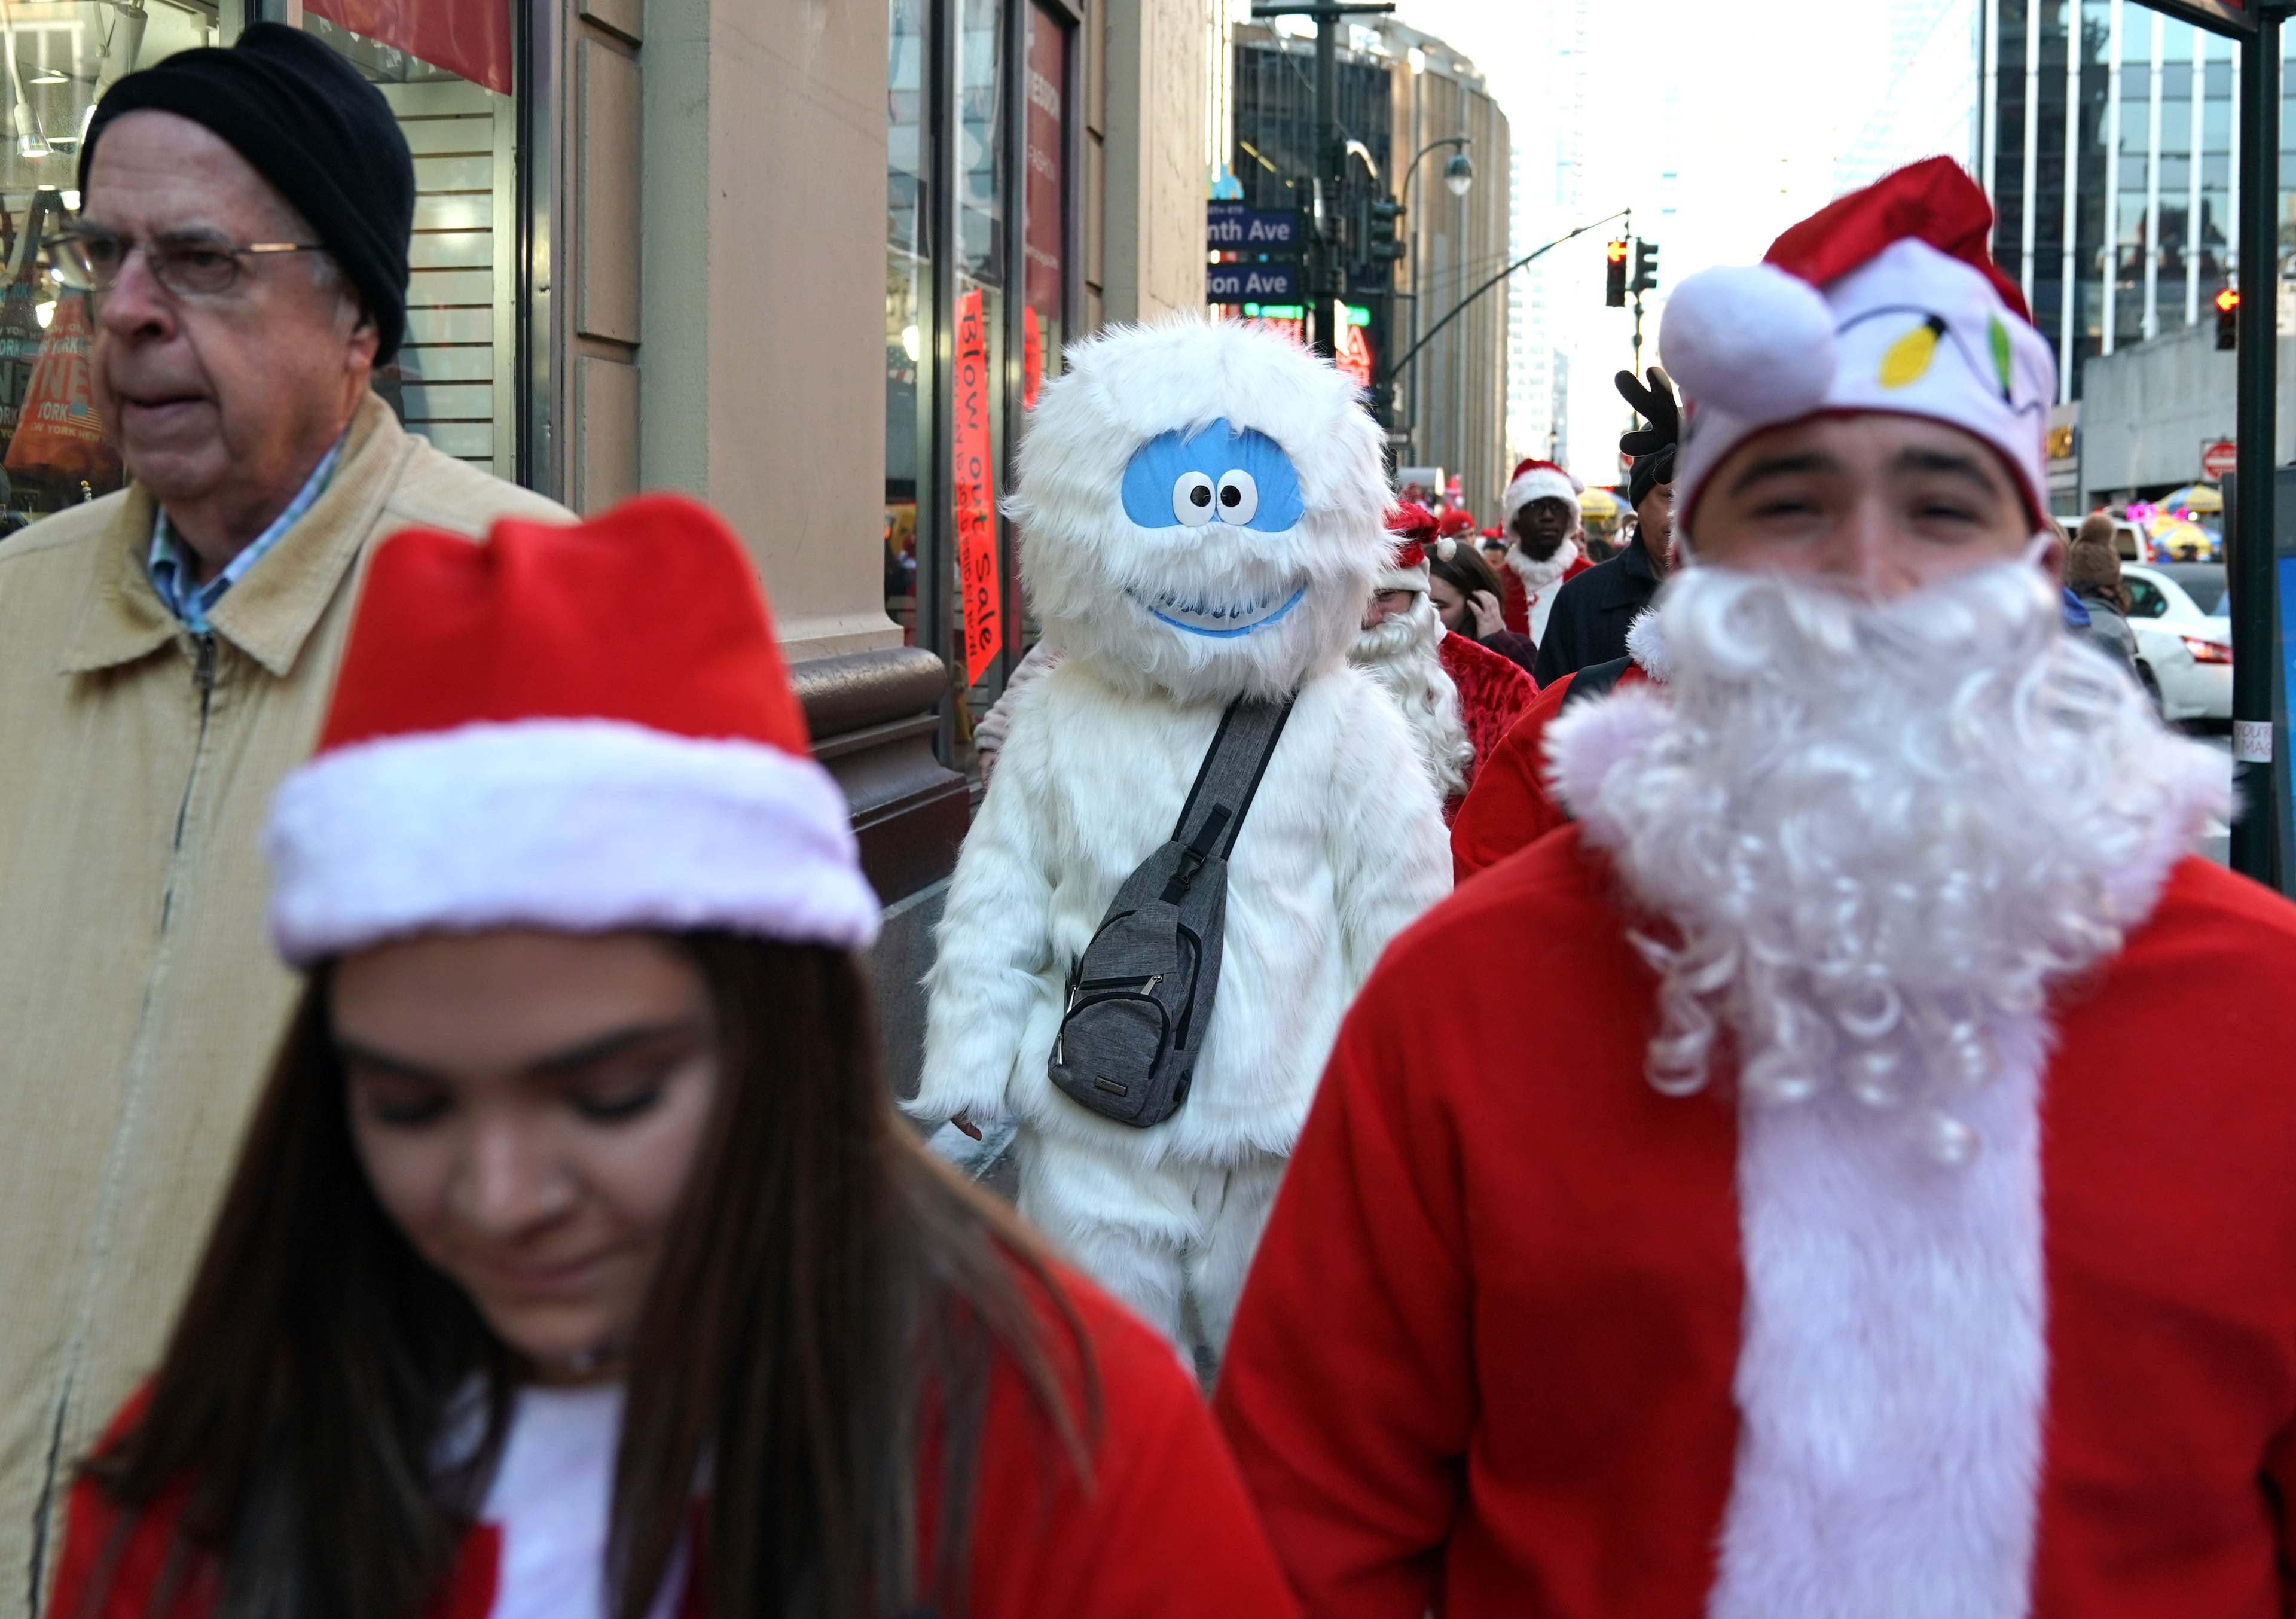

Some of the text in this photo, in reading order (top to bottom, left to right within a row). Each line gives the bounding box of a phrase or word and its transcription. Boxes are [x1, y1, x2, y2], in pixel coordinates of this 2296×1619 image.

[1248, 219, 1290, 240] Ave
[1245, 272, 1287, 294] Ave
[961, 311, 996, 651] Blow out Sale
